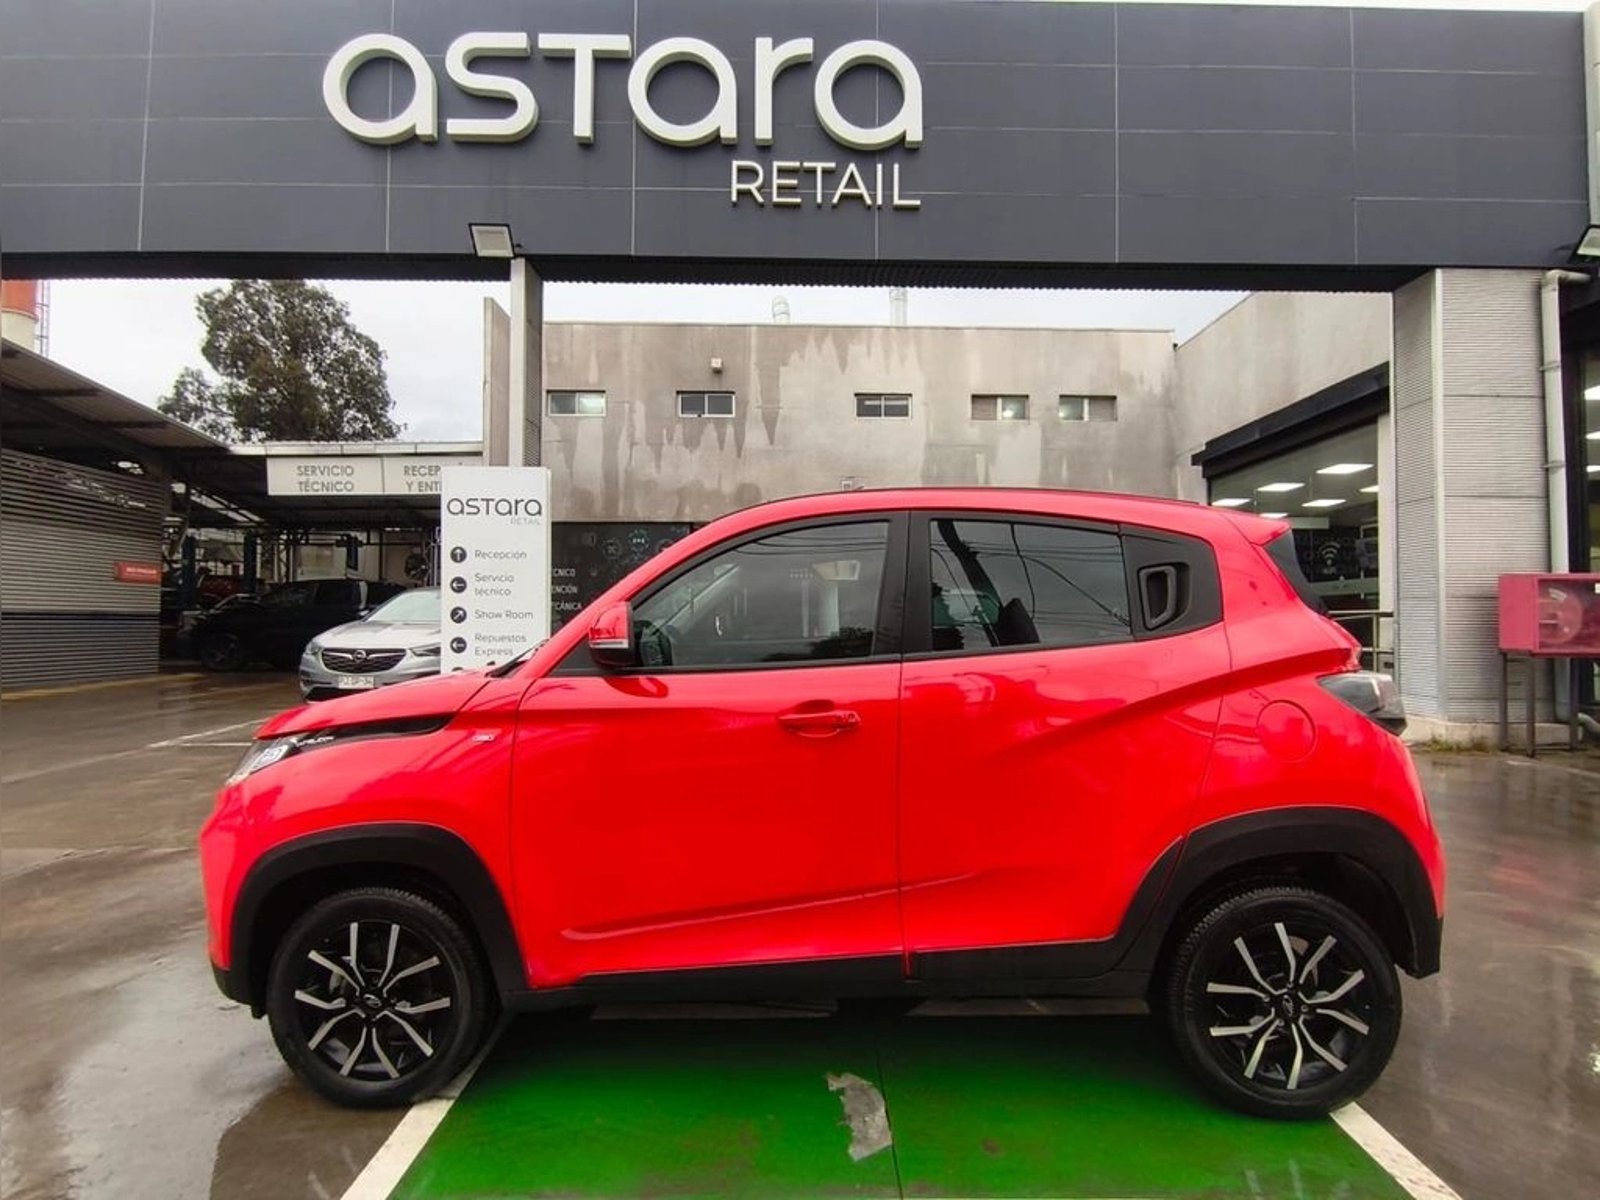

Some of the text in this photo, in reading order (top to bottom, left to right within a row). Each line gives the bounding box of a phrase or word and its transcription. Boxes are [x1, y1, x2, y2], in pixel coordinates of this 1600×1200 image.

[730, 160, 922, 209] RETAIL
[296, 465, 355, 477] SERVICIO
[298, 478, 355, 493] TÉCNICO
[405, 481, 442, 492] Y ENT
[474, 573, 515, 583] Servicio
[474, 587, 512, 597] técnico
[474, 609, 534, 620] Show Room
[474, 633, 527, 644] Repuestos
[474, 647, 513, 657] Express
